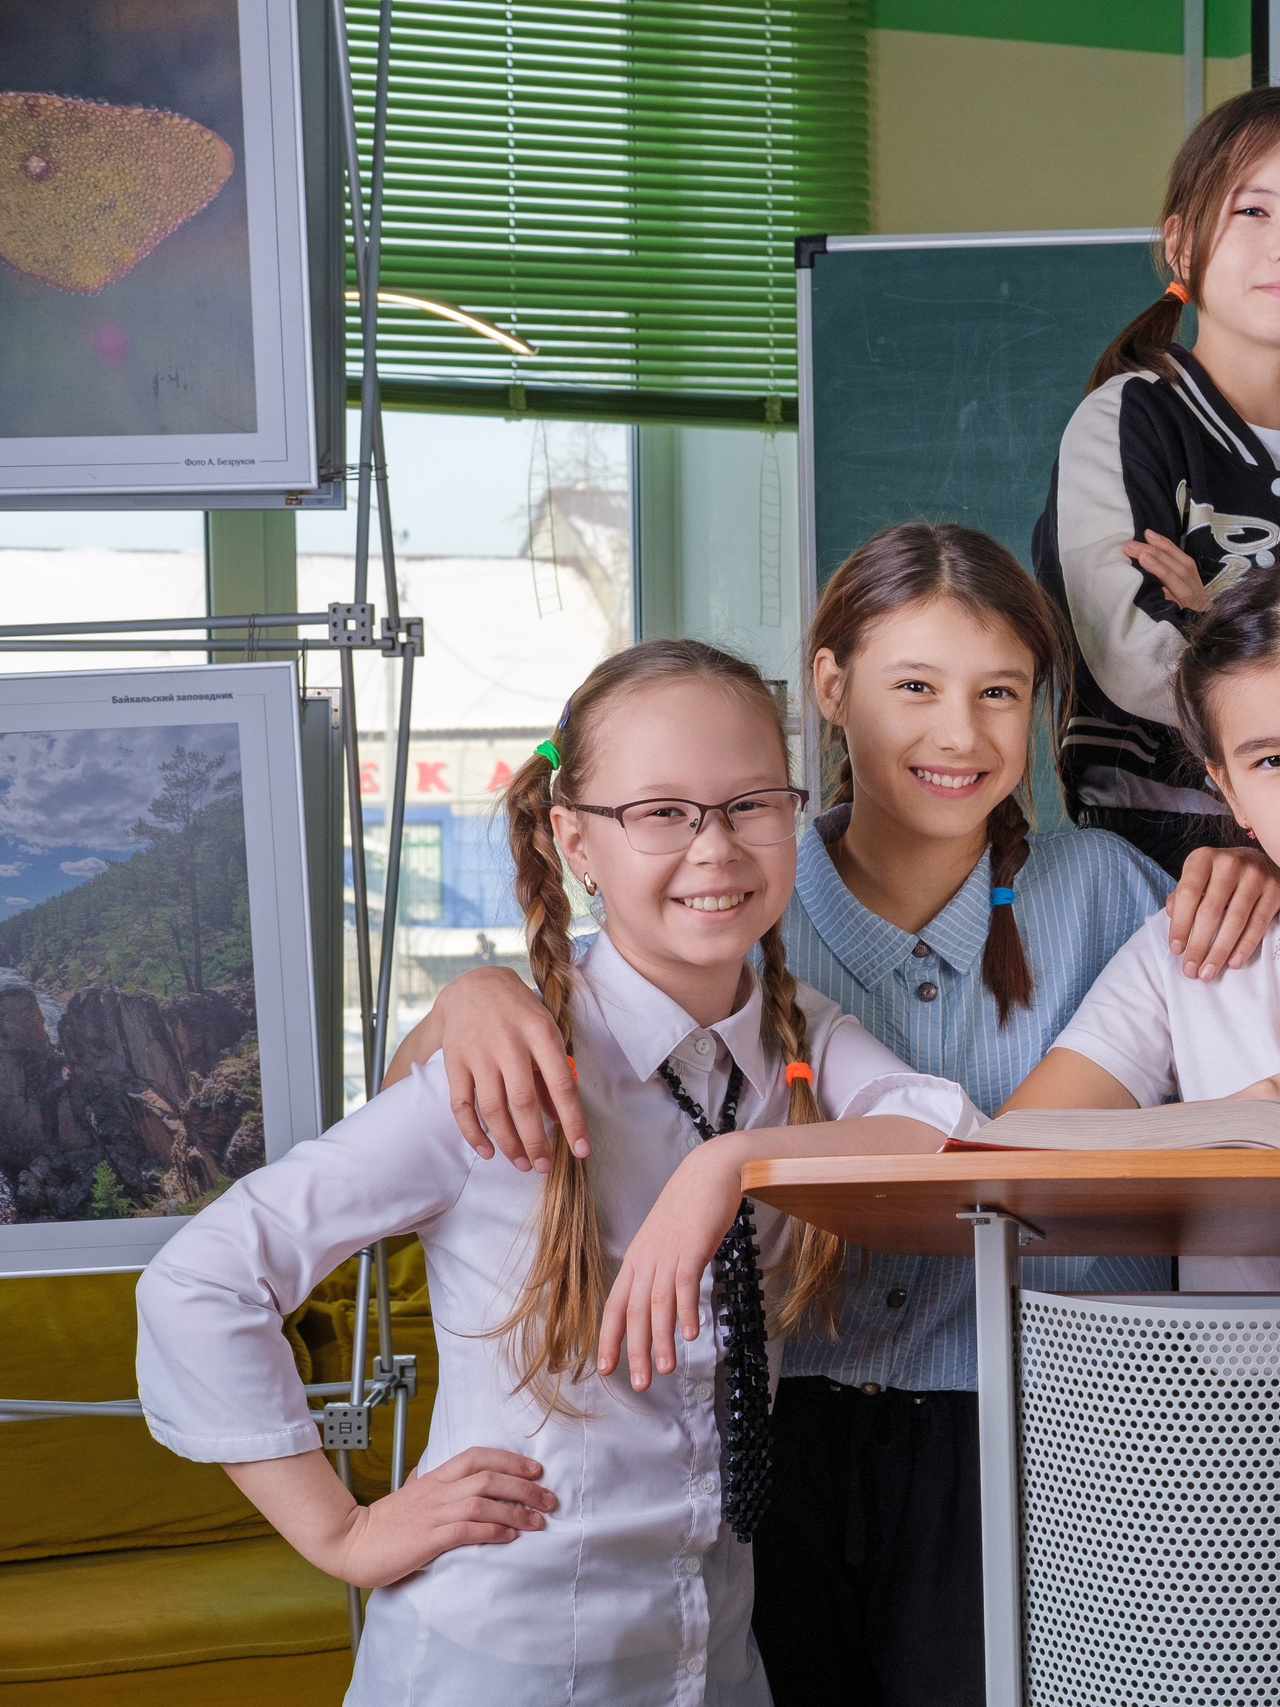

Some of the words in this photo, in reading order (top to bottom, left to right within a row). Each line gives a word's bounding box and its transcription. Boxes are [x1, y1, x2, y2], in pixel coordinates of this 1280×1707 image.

[184, 458, 206, 467] Фото
[207, 458, 216, 466] А.
[217, 458, 256, 467] Безруков
[112, 693, 174, 704] Байкальский
[176, 692, 234, 701] заповедник
